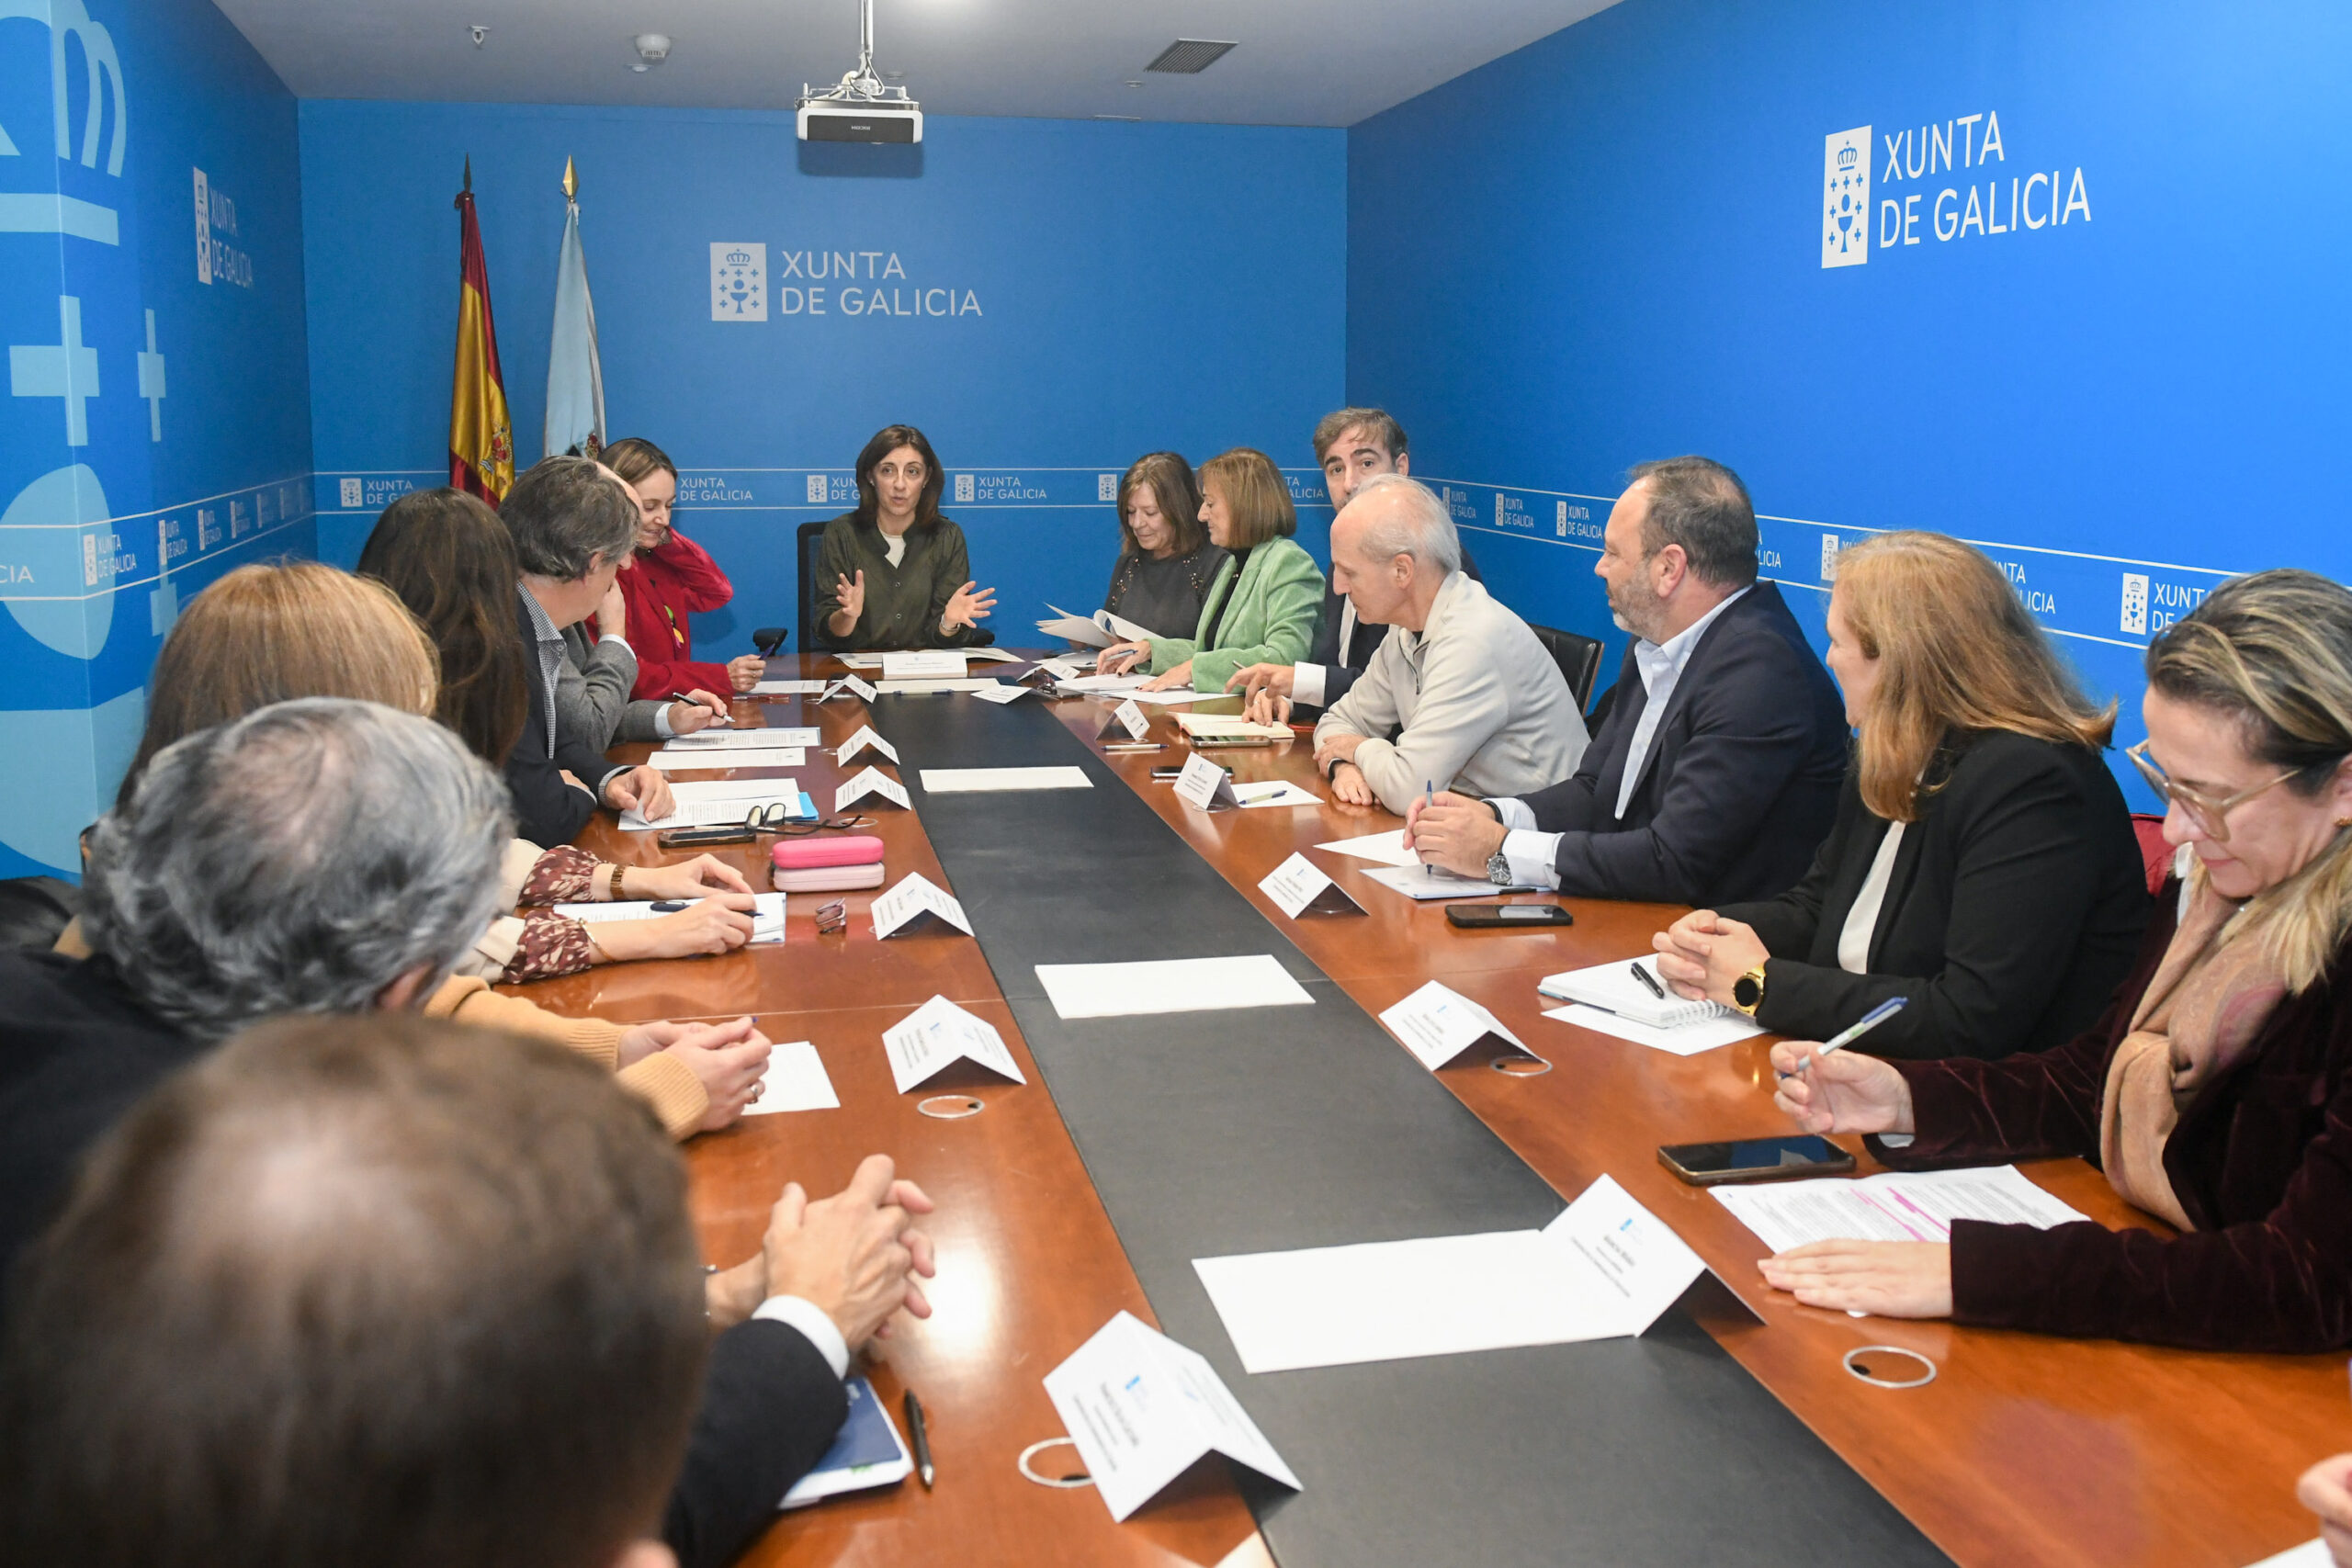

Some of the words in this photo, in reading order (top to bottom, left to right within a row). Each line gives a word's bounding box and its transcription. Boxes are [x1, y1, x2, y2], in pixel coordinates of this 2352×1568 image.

[1883, 110, 2005, 184] XUNTA
[209, 186, 238, 238] XUNTA
[1880, 194, 1922, 248] DE
[1934, 166, 2092, 242] GALICIA
[212, 238, 224, 279] DE
[224, 243, 254, 288] GALICIA
[781, 250, 907, 280] XUNTA
[781, 287, 826, 316] DE
[840, 287, 984, 317] GALICIA
[367, 479, 413, 491] XUNTA
[680, 478, 726, 489] XUNTA
[978, 476, 1022, 487] XUNTA
[367, 492, 384, 504] DE
[680, 490, 695, 501] DE
[701, 490, 753, 502] GALICIA
[831, 489, 847, 501] DE
[978, 489, 994, 499] DE
[998, 489, 1047, 500] GALICIA
[1451, 491, 1467, 502] XUNTA
[1458, 505, 1476, 519] GALICIA
[1504, 497, 1523, 512] XUNTA
[1567, 505, 1590, 521] XUNTA
[1504, 512, 1511, 525] DE
[1512, 513, 1534, 529] GALICIA
[1567, 521, 1576, 535] DE
[1577, 522, 1603, 540] GALICIA
[97, 534, 122, 554] XUNTA
[98, 558, 108, 578] DE
[109, 553, 137, 575] GALICIA
[2154, 582, 2212, 609] XUNT
[2152, 610, 2175, 633] DE
